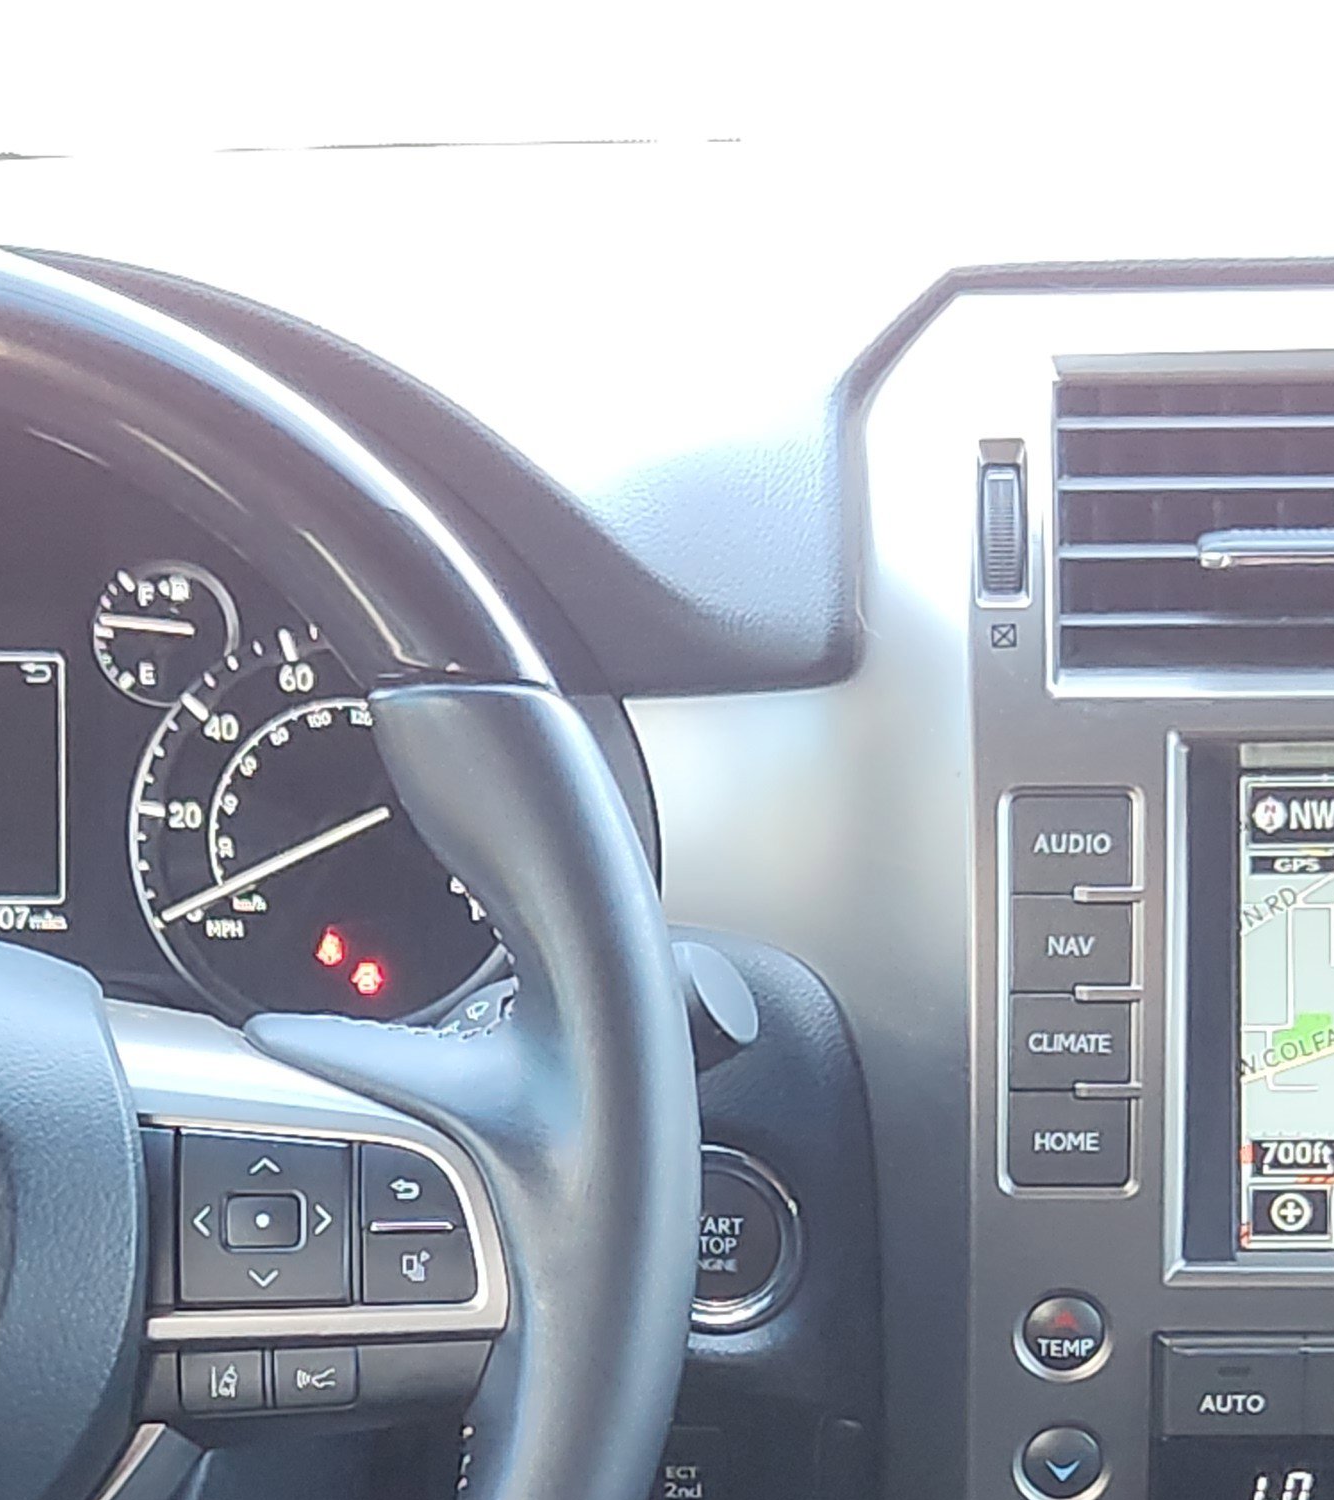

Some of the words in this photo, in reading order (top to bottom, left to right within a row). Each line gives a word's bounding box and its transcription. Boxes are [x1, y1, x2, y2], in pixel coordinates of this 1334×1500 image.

[137, 580, 154, 606] F
[139, 661, 155, 685] E
[279, 665, 314, 692] 60
[204, 713, 239, 742] 40
[168, 801, 202, 829] 20
[1033, 832, 1112, 855] AUDIO
[1272, 857, 1321, 873] GPS
[1264, 886, 1297, 916] RD
[206, 919, 244, 939] MPH
[1046, 936, 1095, 957] NAV
[1027, 1032, 1112, 1055] CLIMATE
[1033, 1131, 1100, 1154] HOME
[1260, 1141, 1334, 1165] 700ft
[699, 1217, 744, 1236] ART
[699, 1235, 738, 1254] TOP
[697, 1258, 739, 1273] NGINE
[1037, 1337, 1095, 1359] TEMP
[1198, 1394, 1267, 1415] AUTO
[665, 1465, 697, 1480] ECT
[664, 1482, 703, 1499] 2nd
